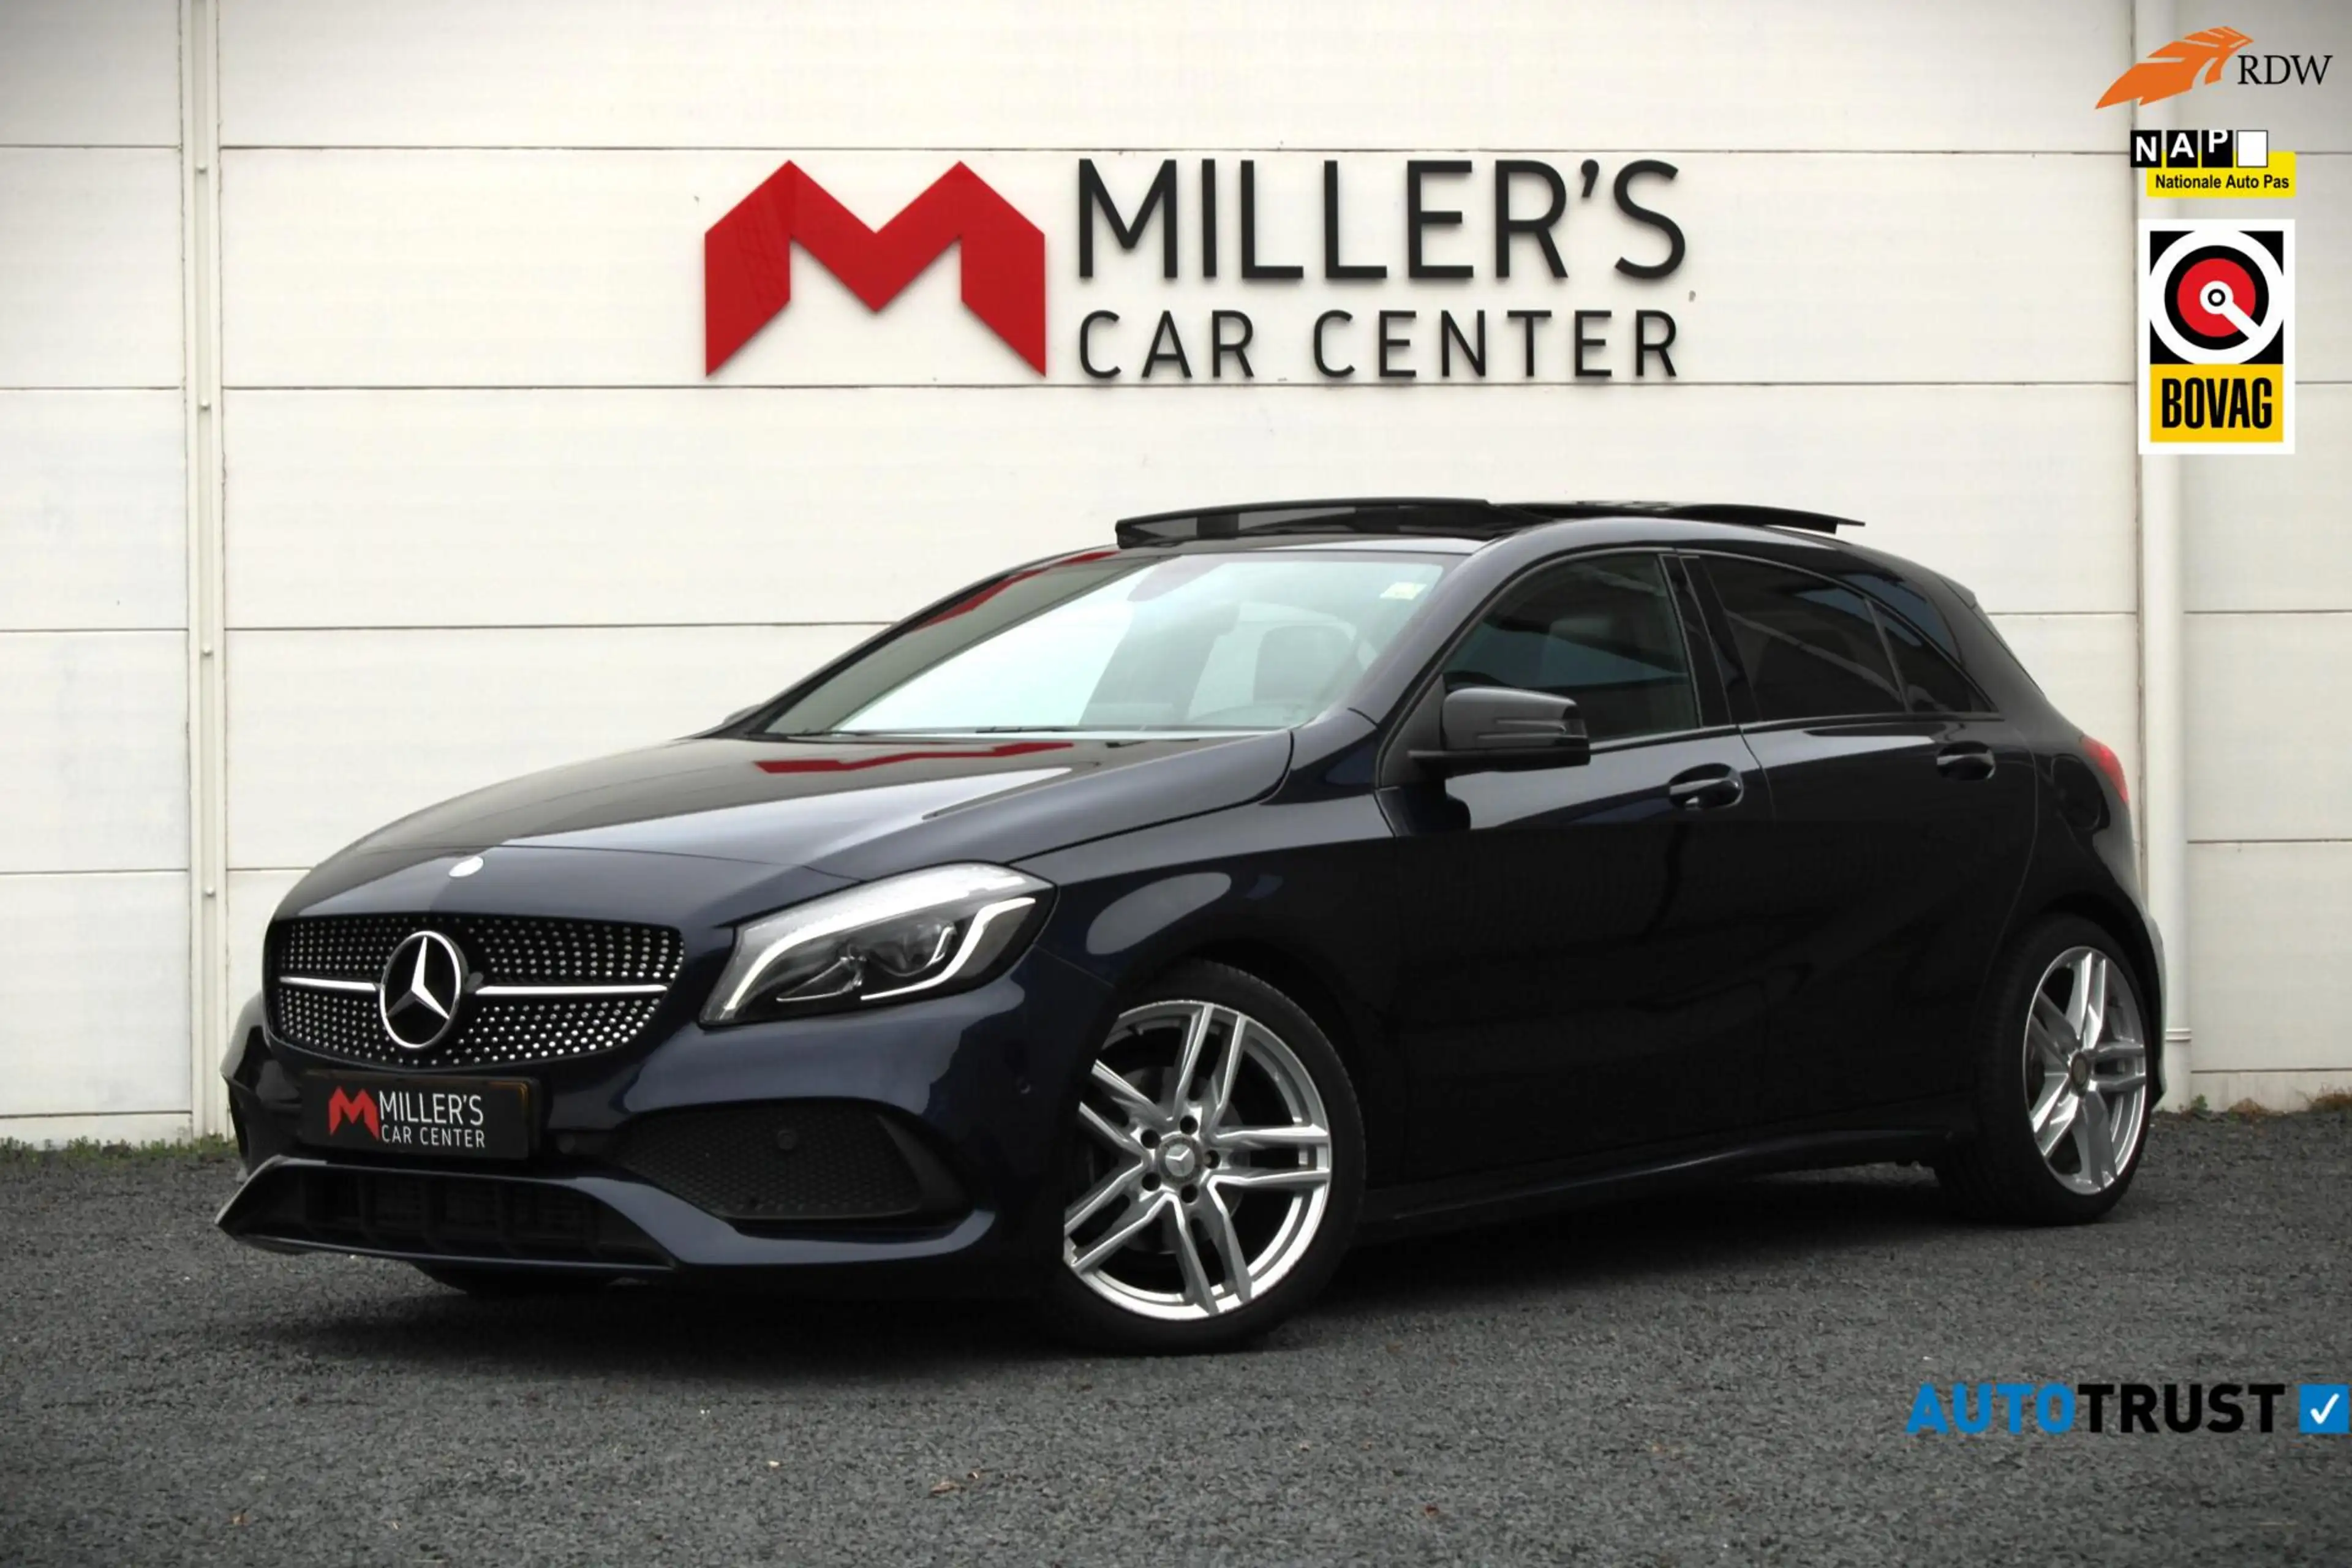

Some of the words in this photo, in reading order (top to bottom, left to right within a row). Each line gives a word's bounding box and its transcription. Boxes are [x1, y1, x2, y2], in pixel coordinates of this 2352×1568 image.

[1078, 158, 1686, 279] MILLER'S
[1079, 310, 1254, 378] CAR
[1313, 310, 1677, 378] CENTER
[379, 1090, 484, 1126] MILLER'S
[381, 1125, 412, 1144] CAR
[420, 1127, 485, 1148] CENTER
